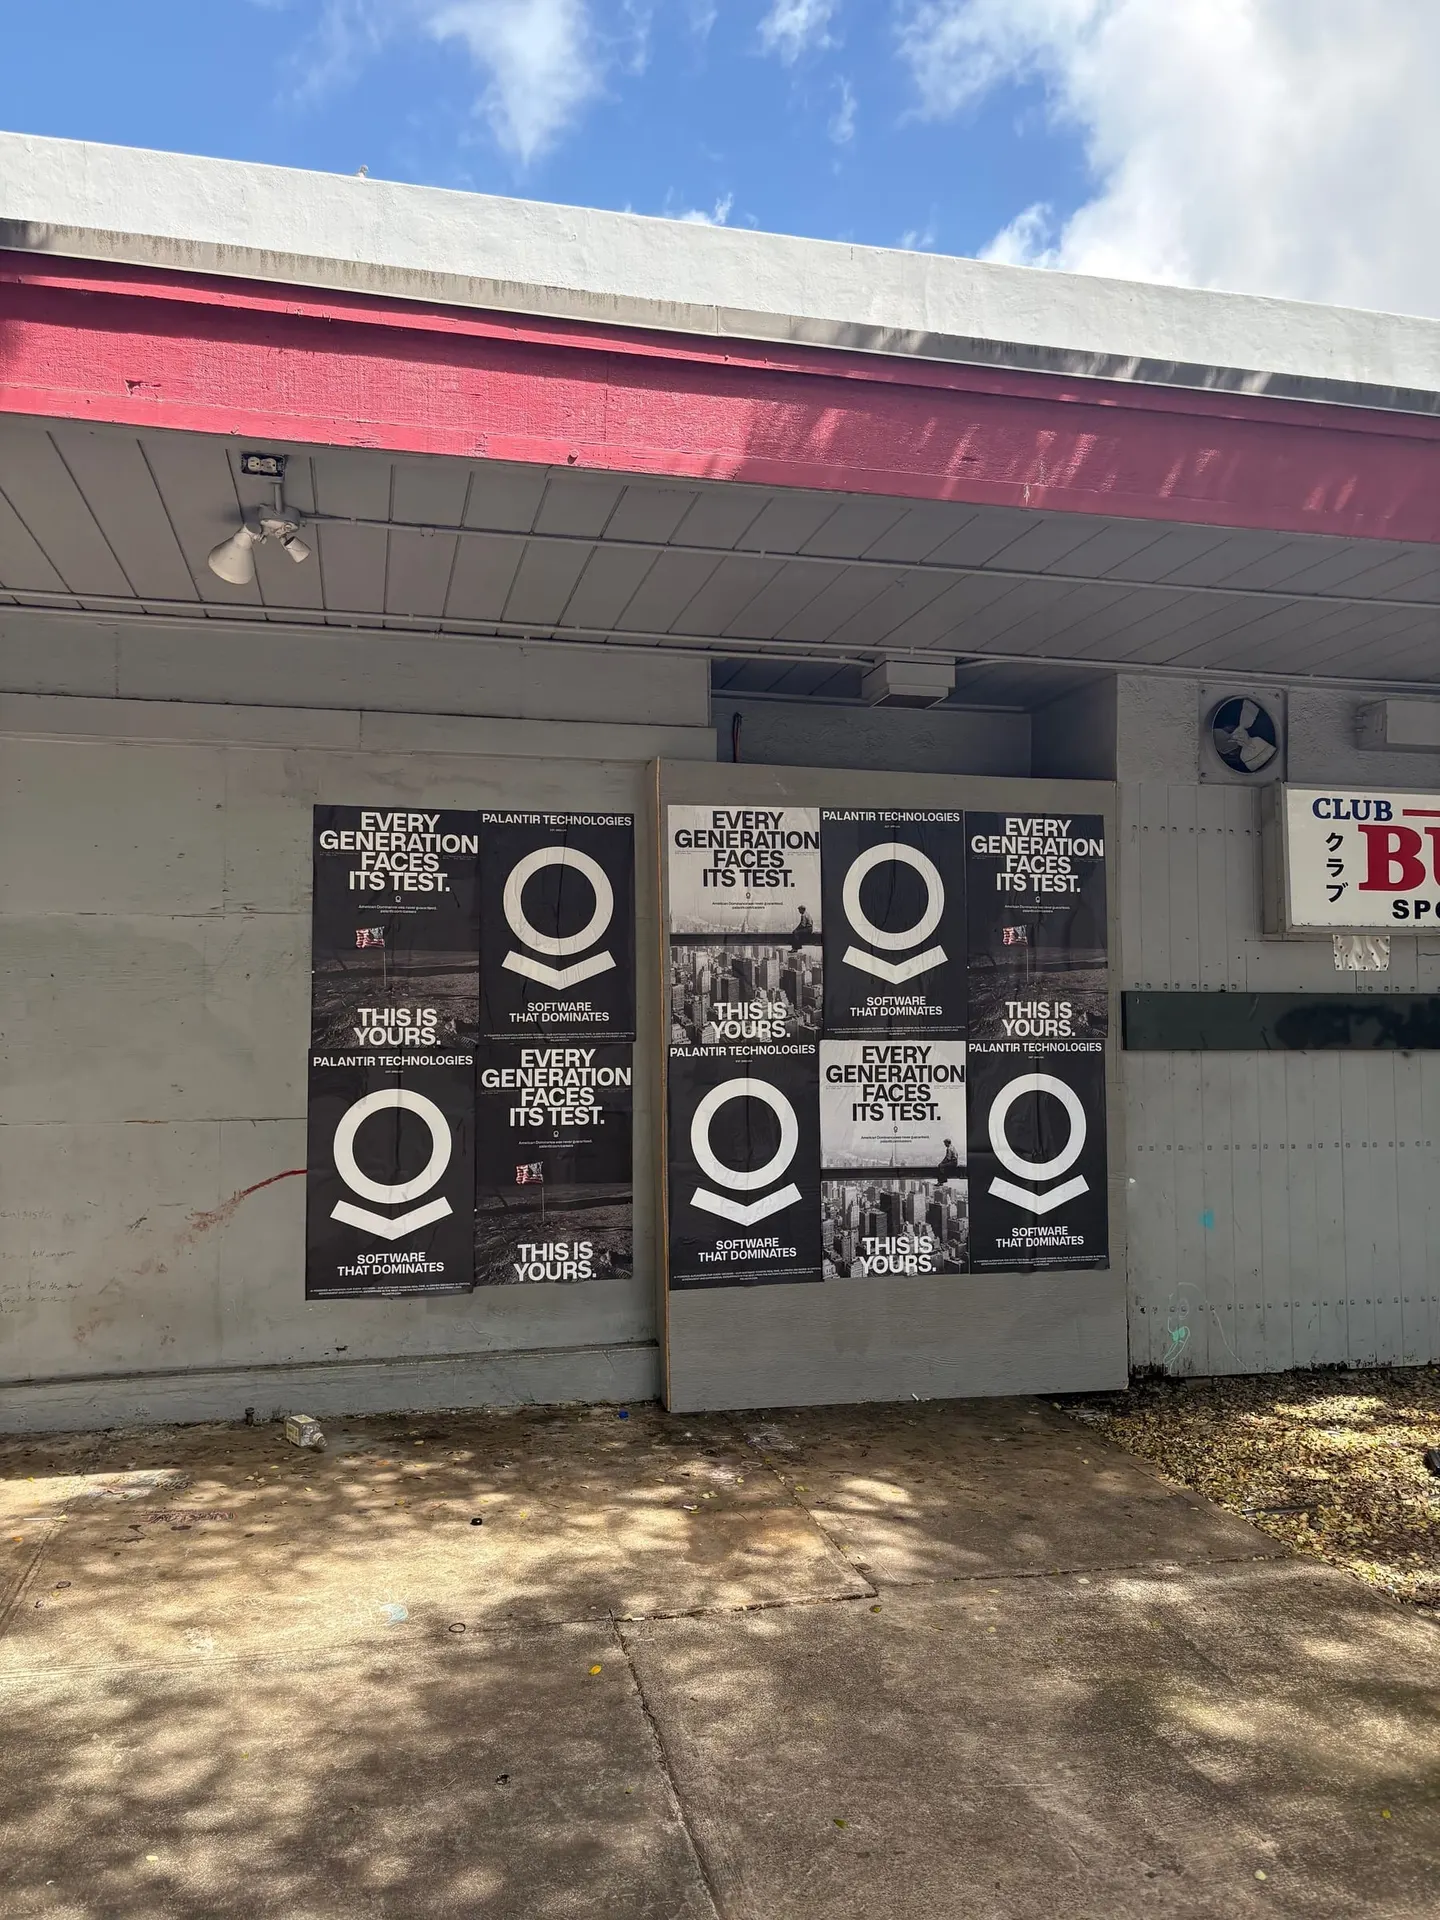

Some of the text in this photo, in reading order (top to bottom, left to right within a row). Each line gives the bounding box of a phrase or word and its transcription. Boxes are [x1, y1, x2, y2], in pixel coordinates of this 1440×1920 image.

[822, 811, 960, 823] PALANTIR TECHNOLOGIES
[1312, 797, 1393, 821] CLUB
[361, 812, 440, 833] EVERY
[482, 813, 632, 827] PALANTIR TECHNOLOGIES
[712, 810, 784, 830] EVERY
[1005, 818, 1072, 837] EVERY
[319, 831, 478, 853] GENERATION
[674, 829, 820, 850] GENERATION
[971, 835, 1104, 857] GENERATION
[361, 852, 439, 872] FACES
[713, 849, 785, 868] FACES
[1006, 856, 1071, 874] FACES
[1326, 832, 1349, 903] クラブ
[1357, 824, 1440, 892] B
[349, 871, 450, 892] ITS TEST.
[702, 868, 795, 888] ITS TEST.
[996, 873, 1081, 894] ITS TEST.
[527, 1002, 592, 1012] SOFTWARE
[866, 996, 926, 1006] SOFTWARE
[1004, 1001, 1072, 1019] THIS IS
[357, 1007, 437, 1027] THIS IS
[509, 1011, 610, 1023] THAT DOMINATES
[714, 1002, 787, 1020] THIS IS
[850, 1005, 943, 1017] THAT DOMINATES
[354, 1027, 441, 1046] YOURS.
[710, 1020, 791, 1039] YOURS.
[1002, 1019, 1076, 1038] YOURS.
[669, 1043, 816, 1057] PALANTIR TECHNOLOGIES
[861, 1045, 932, 1064] EVERY
[968, 1042, 1102, 1052] PALANTIR TECHNOLOGIES
[313, 1055, 473, 1067] PALANTIR TECHNOLOGIES
[521, 1049, 596, 1068] EVERY
[481, 1068, 631, 1088] GENERATION
[825, 1065, 965, 1083] GENERATION
[520, 1087, 594, 1107] FACES
[862, 1083, 931, 1102] FACES
[509, 1107, 605, 1127] ITS TEST.
[851, 1103, 941, 1121] ITS TEST.
[1011, 1226, 1068, 1237] SOFTWARE
[716, 1237, 779, 1250] SOFTWARE
[862, 1236, 933, 1255] THIS IS
[996, 1234, 1085, 1249] THAT DOMINATES
[357, 1252, 426, 1264] SOFTWARE
[517, 1242, 593, 1262] THIS IS
[698, 1247, 797, 1261] THAT DOMINATES
[337, 1262, 444, 1276] THAT DOMINATES
[513, 1262, 597, 1280] YOURS.
[859, 1254, 936, 1274] YOURS.
